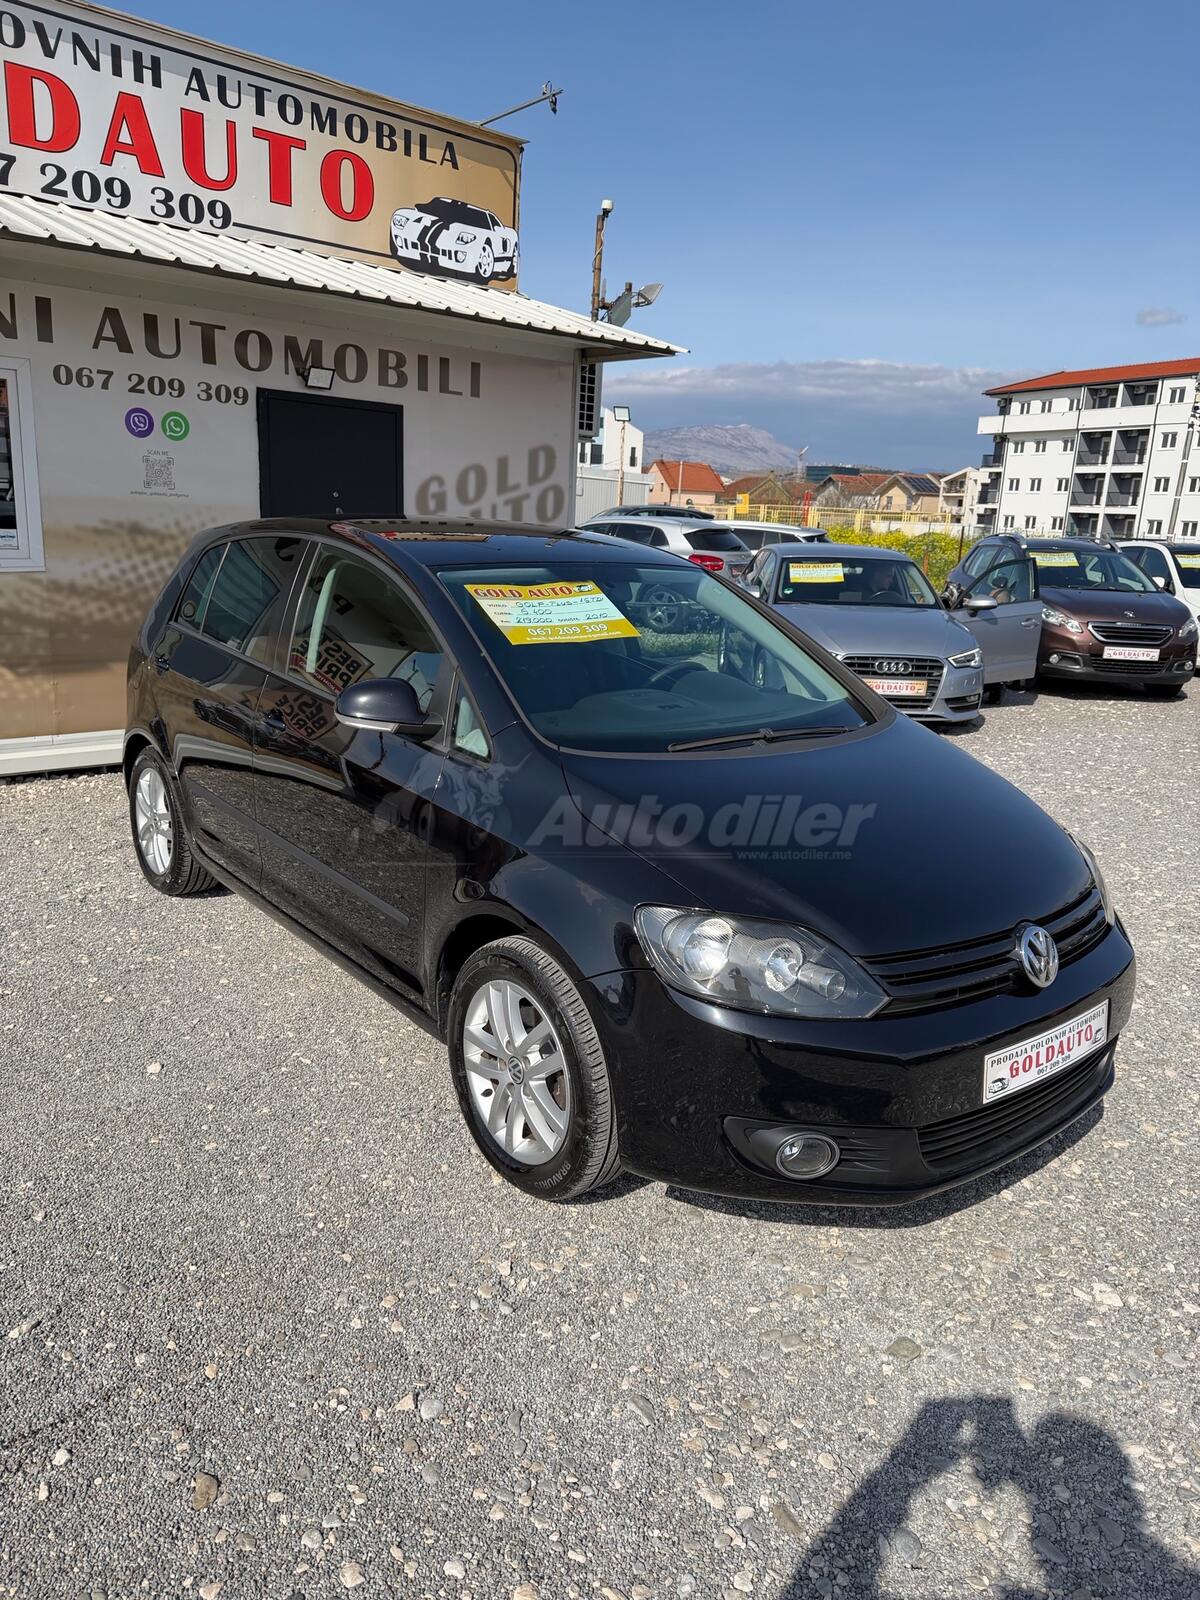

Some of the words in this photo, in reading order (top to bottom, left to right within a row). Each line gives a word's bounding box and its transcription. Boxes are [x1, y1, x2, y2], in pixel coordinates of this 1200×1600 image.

[3, 60, 375, 222] DAUTO
[184, 67, 459, 170] AUTOMOBILA
[40, 162, 132, 209] 209
[150, 186, 232, 229] 309
[92, 306, 480, 398] AUTOMOBILI
[52, 364, 114, 390] 067
[127, 373, 185, 398] 209
[197, 381, 249, 406] 309
[415, 444, 557, 516] GOLD
[473, 588, 523, 598] GOLD
[528, 585, 573, 598] AUTO
[528, 627, 552, 636] 067
[556, 626, 581, 635] 209
[582, 623, 608, 633] 309
[990, 1047, 1028, 1068] PRODAJA
[1030, 1029, 1067, 1053] POLOVNIH
[1067, 1007, 1105, 1034] AUTOMOBILA
[1009, 1024, 1093, 1079] GOLDAUTO
